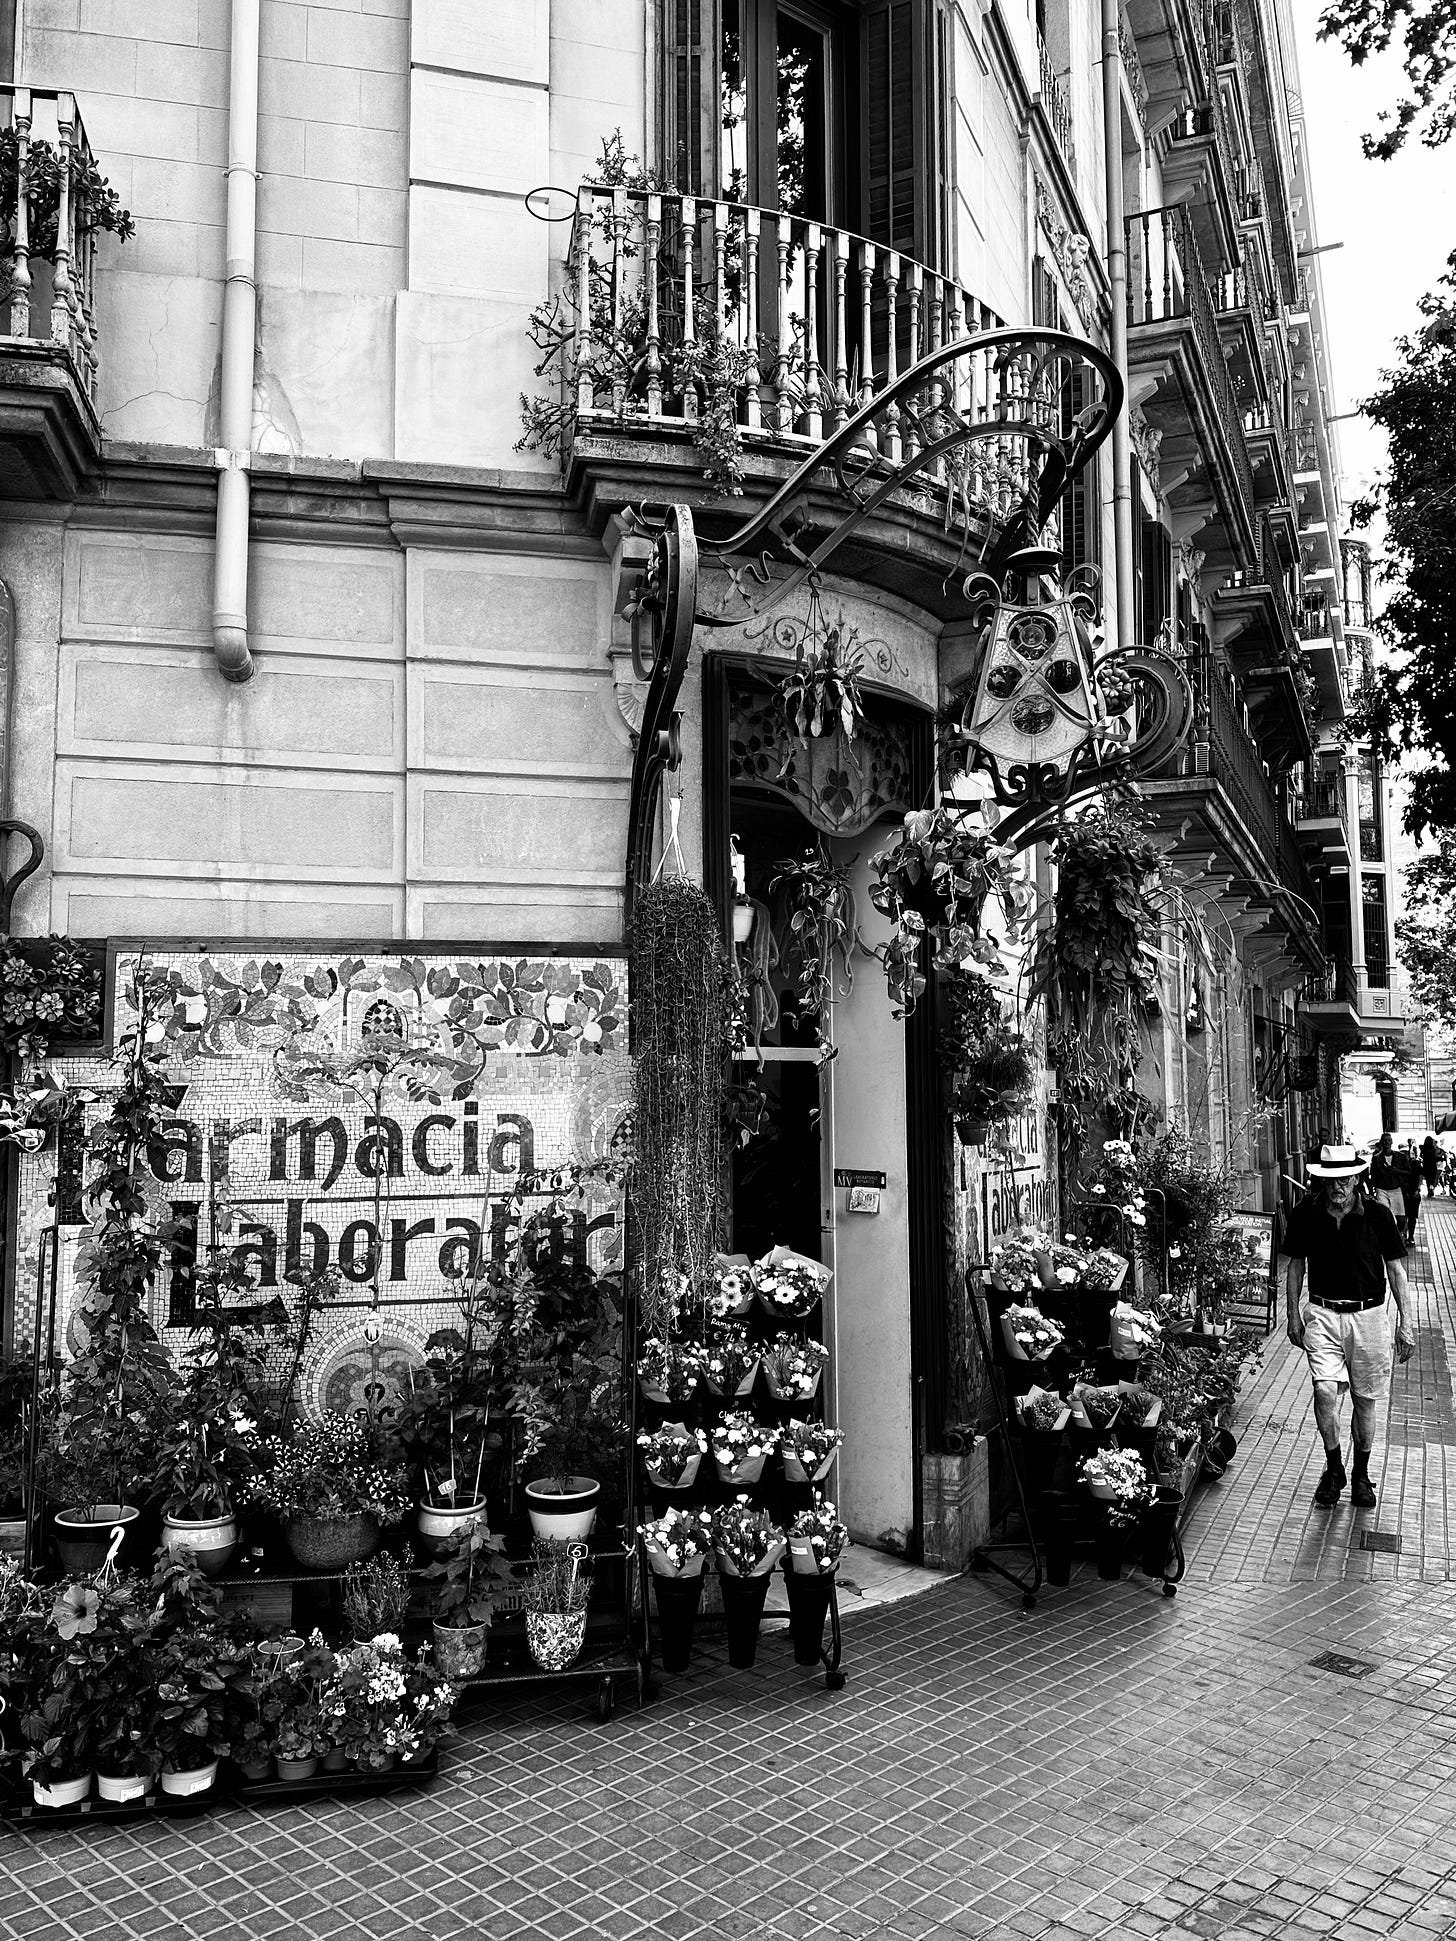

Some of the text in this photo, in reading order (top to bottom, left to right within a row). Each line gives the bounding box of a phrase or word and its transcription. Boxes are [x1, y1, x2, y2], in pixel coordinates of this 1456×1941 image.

[837, 1175, 853, 1187] MV
[723, 1332, 735, 1343] 14
[571, 1545, 582, 1557] 6
